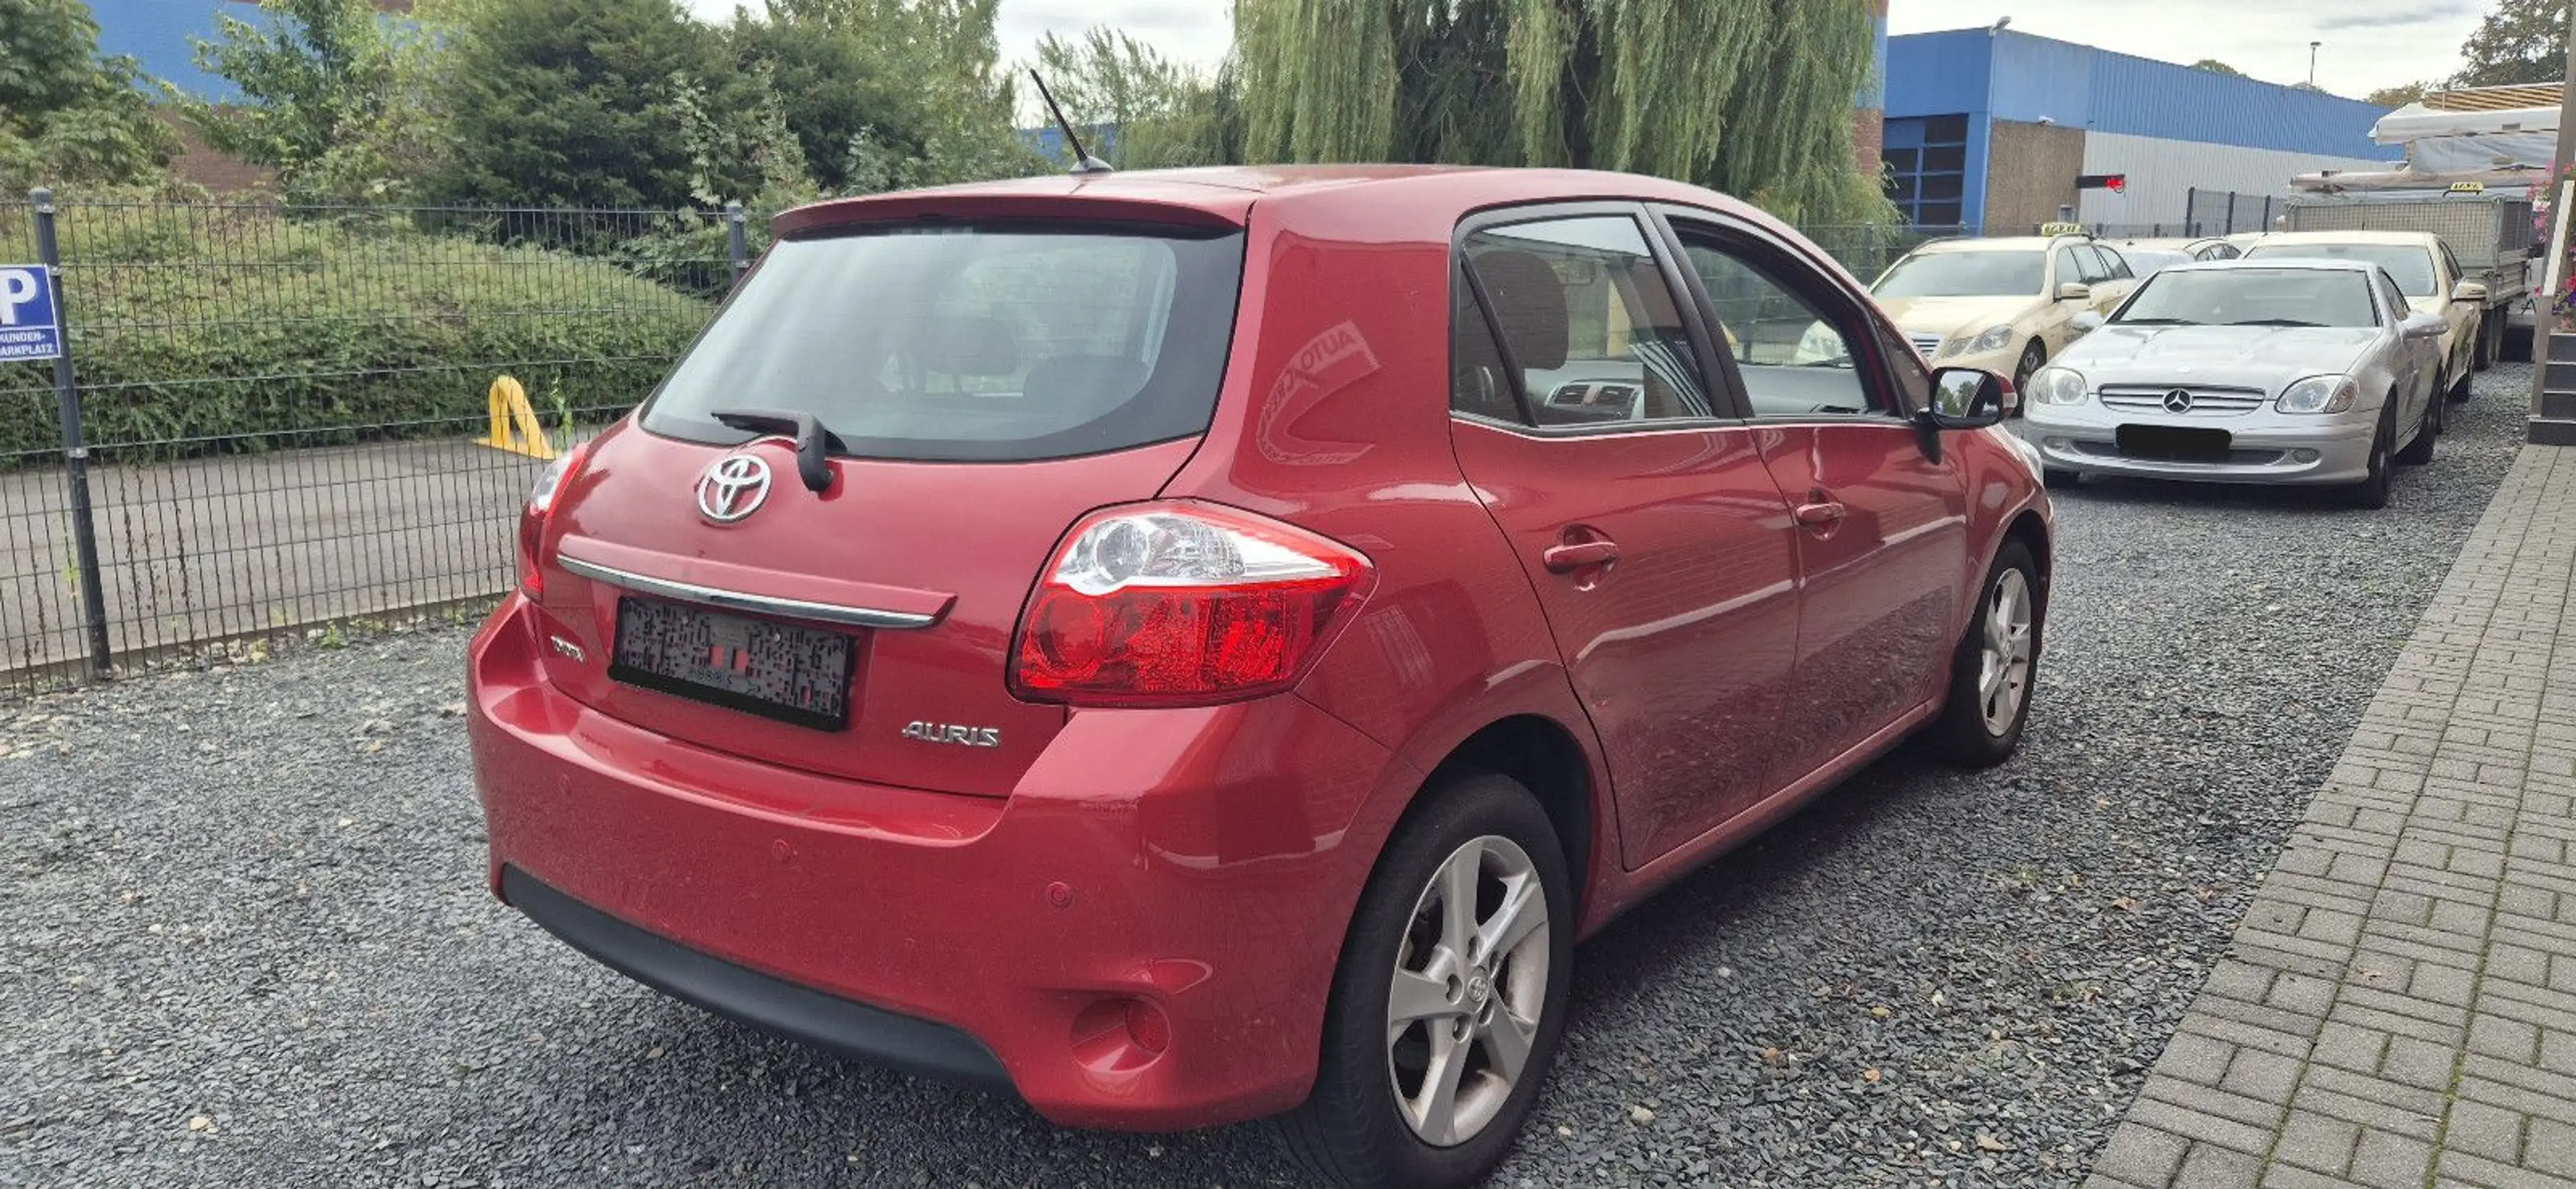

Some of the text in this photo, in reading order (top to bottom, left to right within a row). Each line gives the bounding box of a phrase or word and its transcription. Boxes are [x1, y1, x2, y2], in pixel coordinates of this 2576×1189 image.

[0, 269, 36, 324] P
[0, 343, 54, 356] ARKPLATZ
[902, 720, 1000, 747] AURIS
